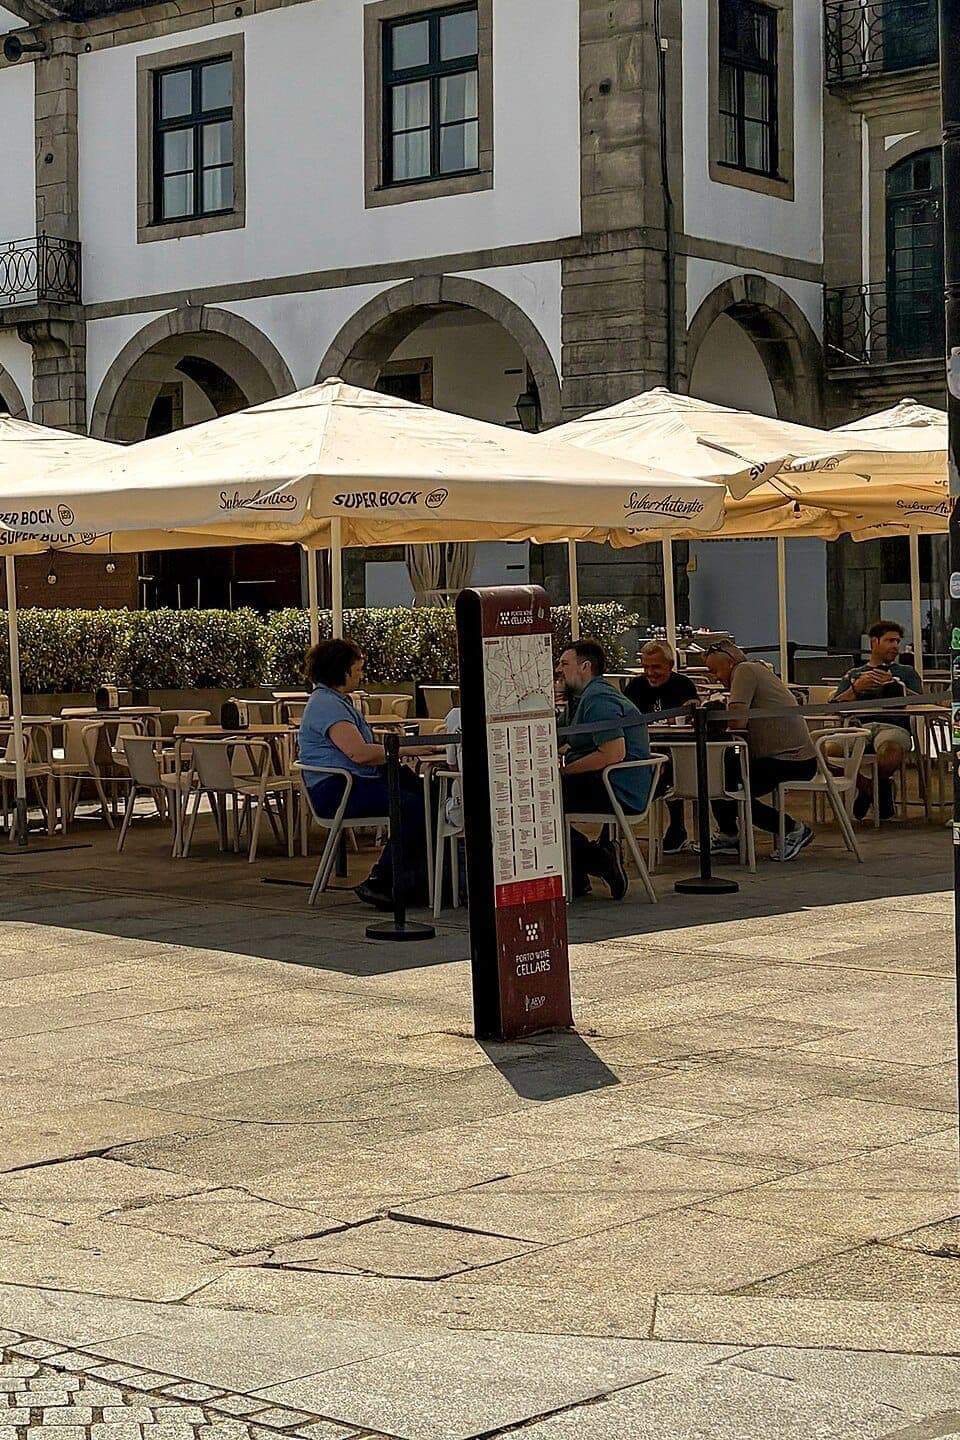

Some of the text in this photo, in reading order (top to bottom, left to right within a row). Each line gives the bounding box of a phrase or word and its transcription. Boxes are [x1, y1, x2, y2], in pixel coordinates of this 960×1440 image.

[332, 492, 378, 509] SUPER
[380, 491, 422, 506] BOCK
[21, 509, 54, 525] BOCK
[515, 952, 535, 963] PORTO
[516, 960, 551, 977] CELLARS
